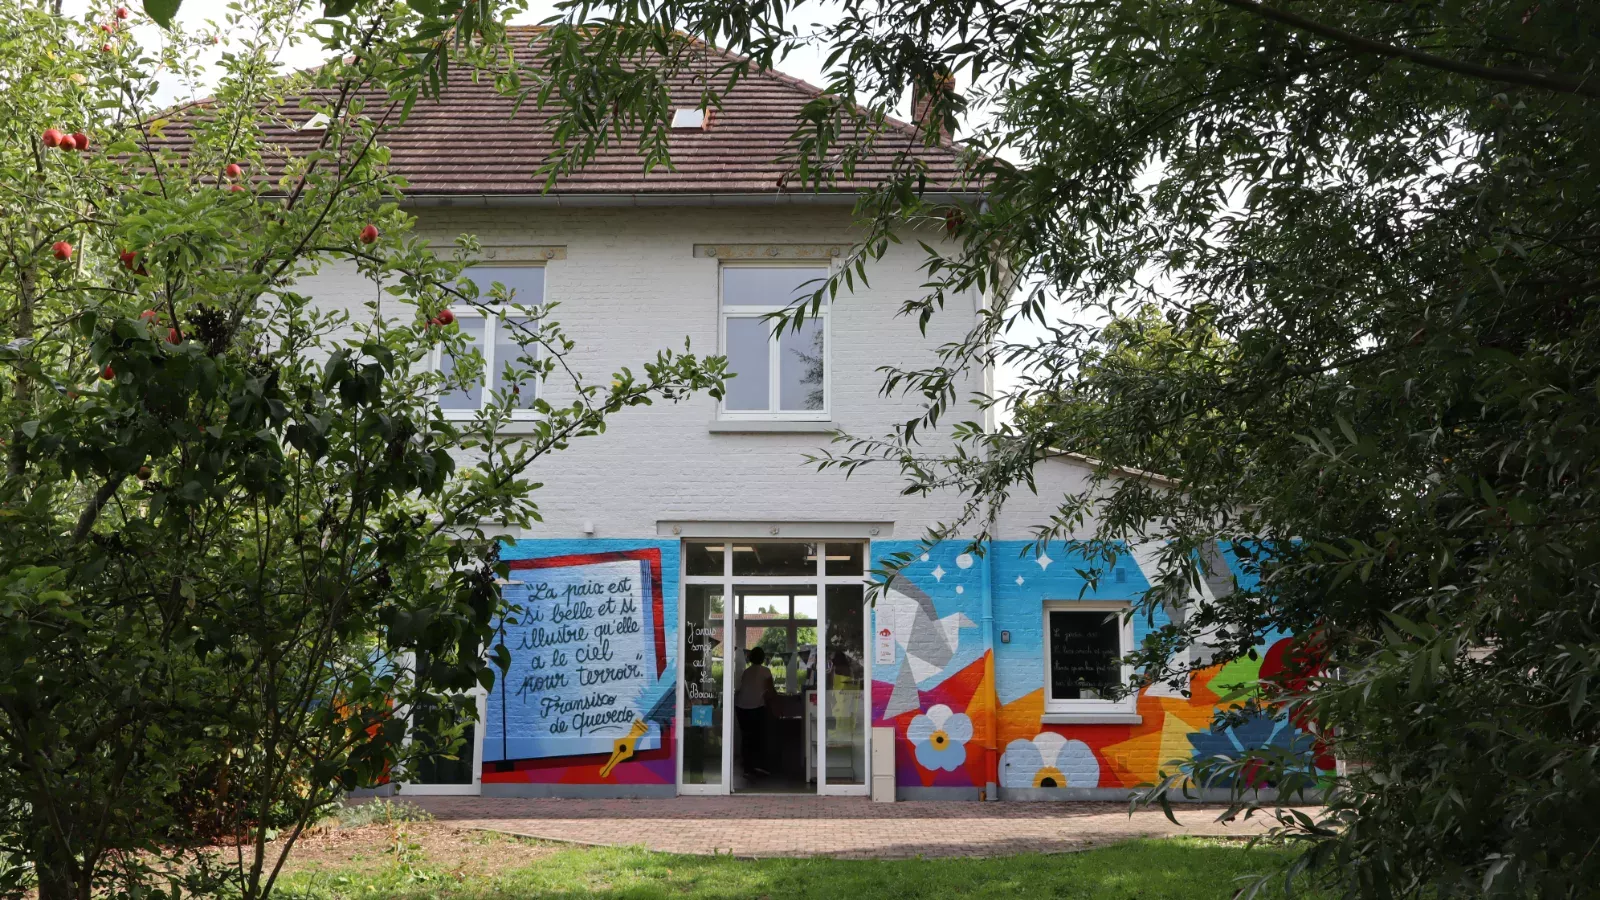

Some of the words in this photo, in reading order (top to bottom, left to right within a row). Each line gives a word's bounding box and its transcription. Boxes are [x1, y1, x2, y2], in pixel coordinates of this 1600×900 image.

[562, 580, 604, 607] paix
[608, 577, 631, 594] est
[520, 606, 544, 627] si
[551, 600, 594, 624] belle
[598, 597, 617, 616] et
[620, 593, 637, 613] si
[516, 625, 589, 650] illustre
[594, 616, 640, 645] qu'elle
[531, 658, 545, 670] a
[551, 649, 568, 667] le
[576, 638, 613, 663] ciel
[515, 672, 568, 704] pour
[550, 717, 568, 734] de
